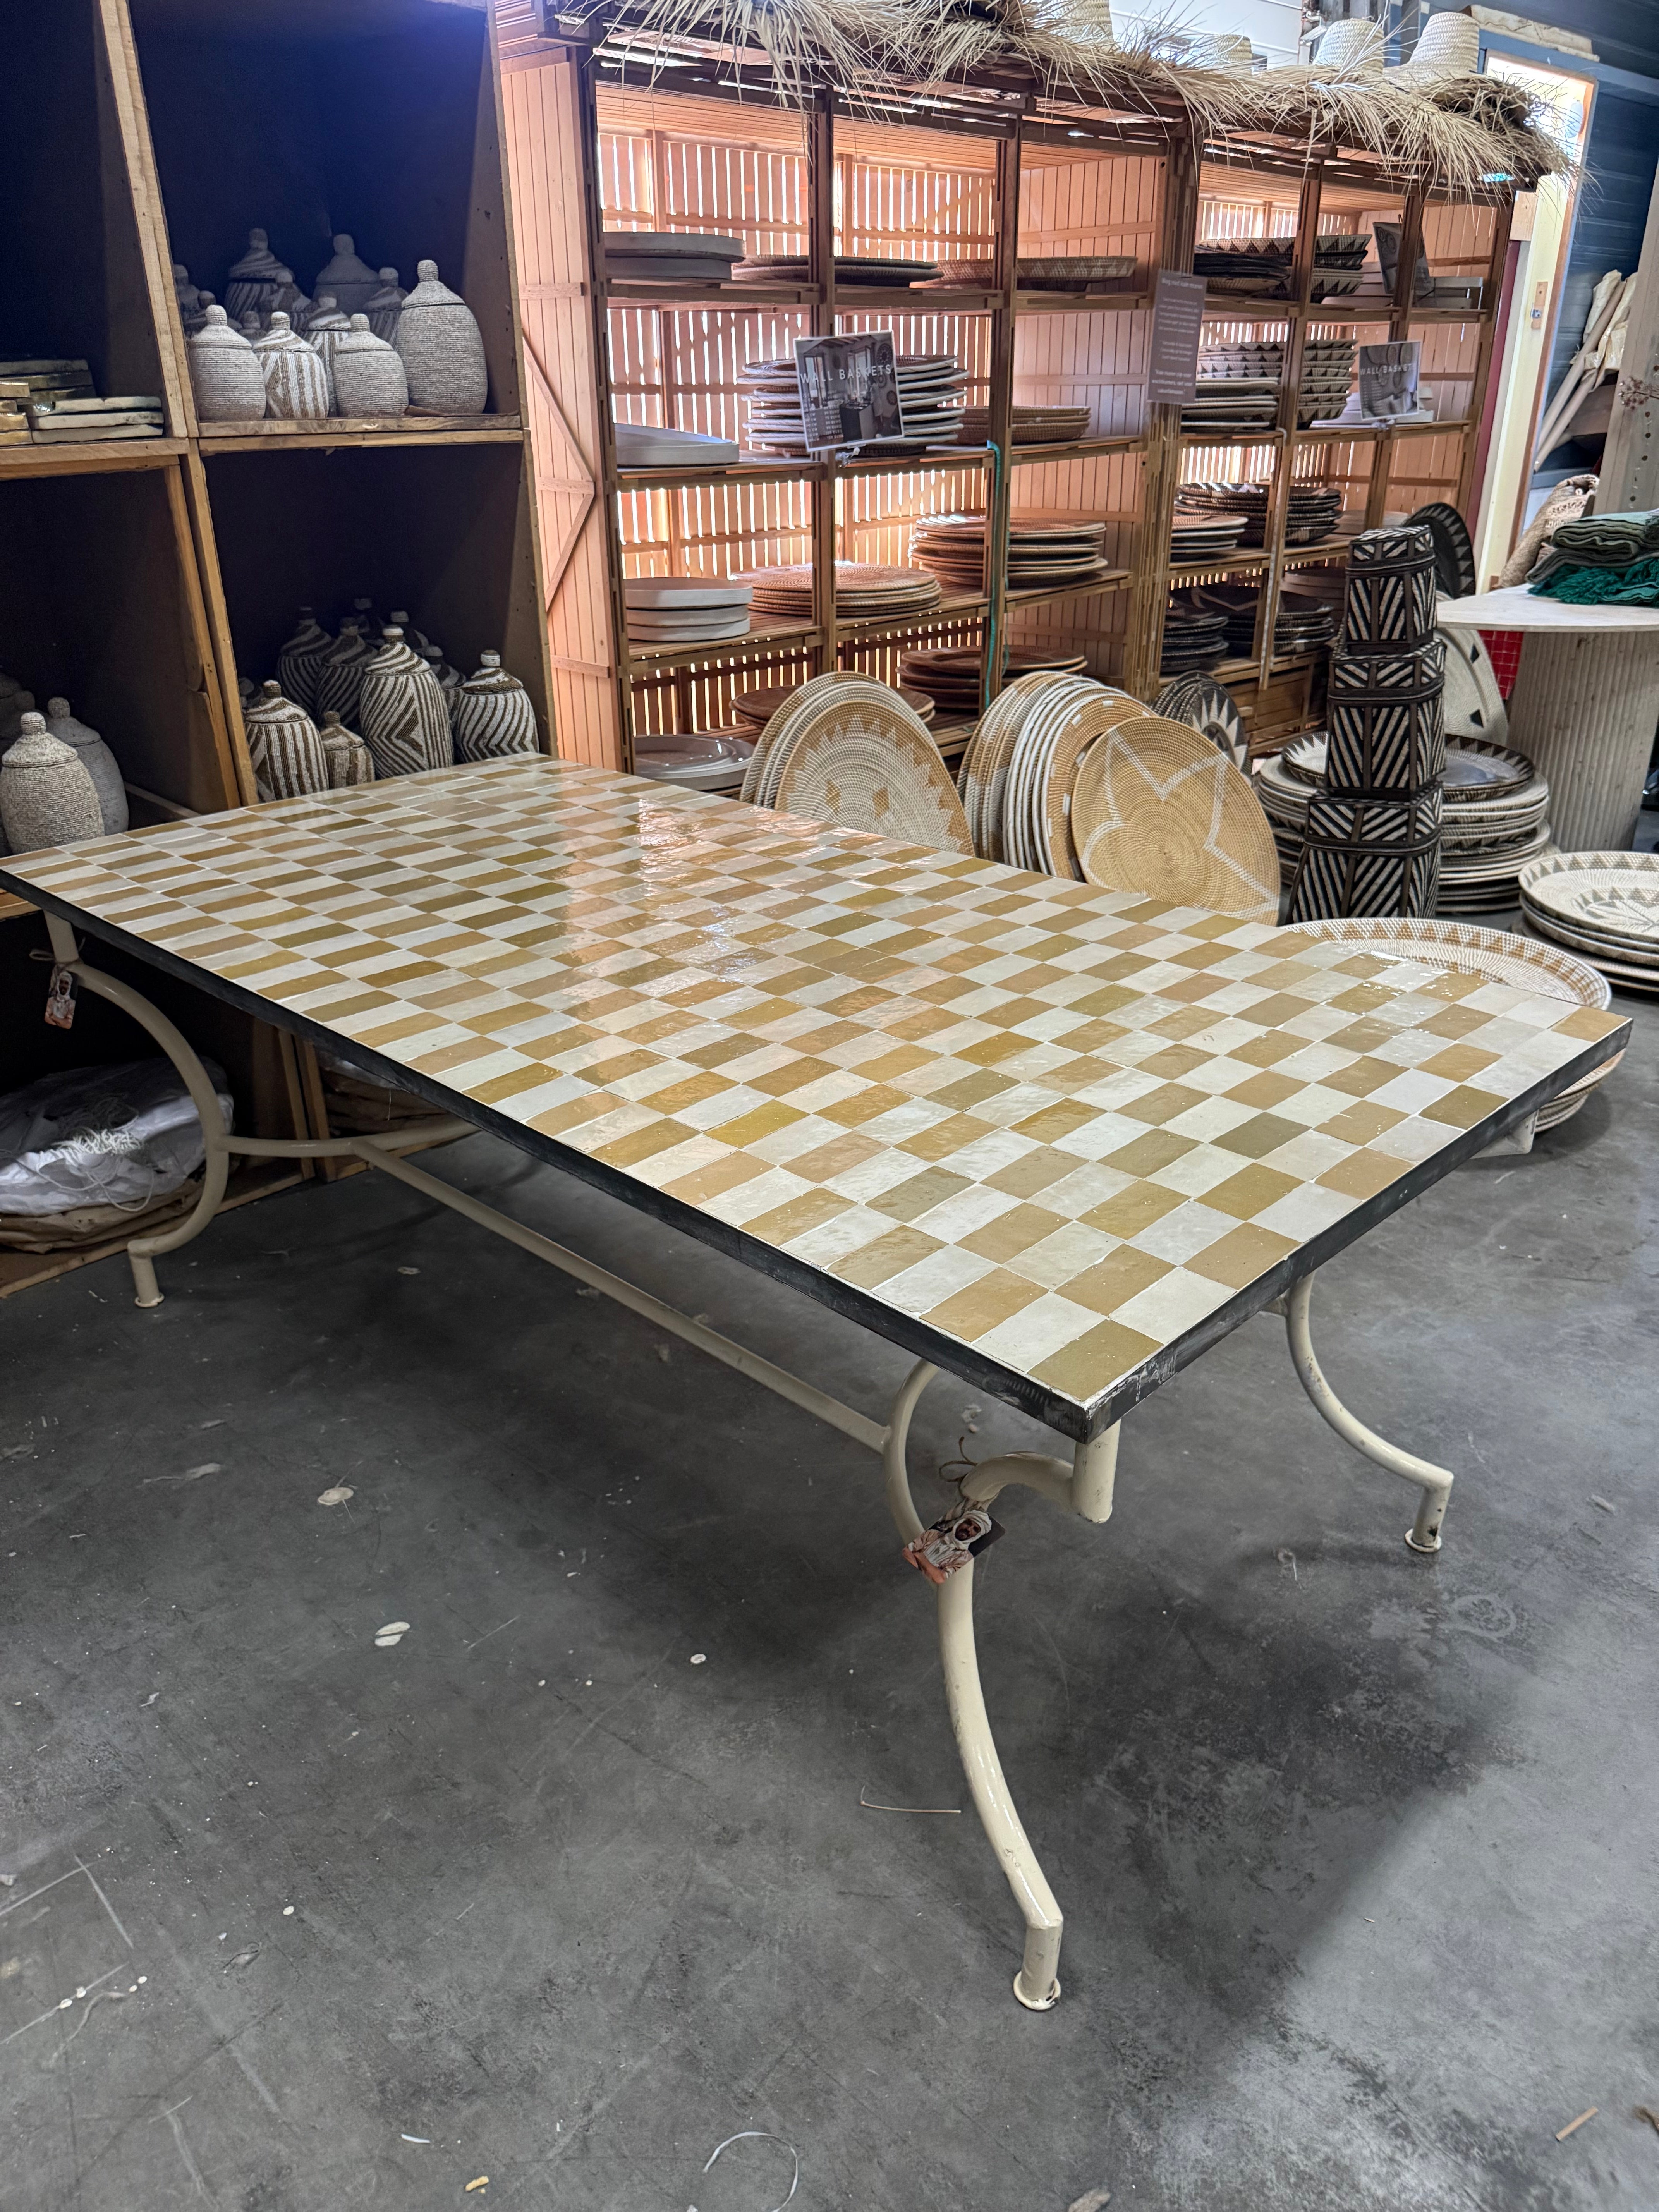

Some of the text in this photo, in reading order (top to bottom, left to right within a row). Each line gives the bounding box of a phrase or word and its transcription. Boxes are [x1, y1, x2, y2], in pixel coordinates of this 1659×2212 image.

[800, 364, 891, 384] WALL BASKETS
[1360, 363, 1416, 375] WALL BASKETS
